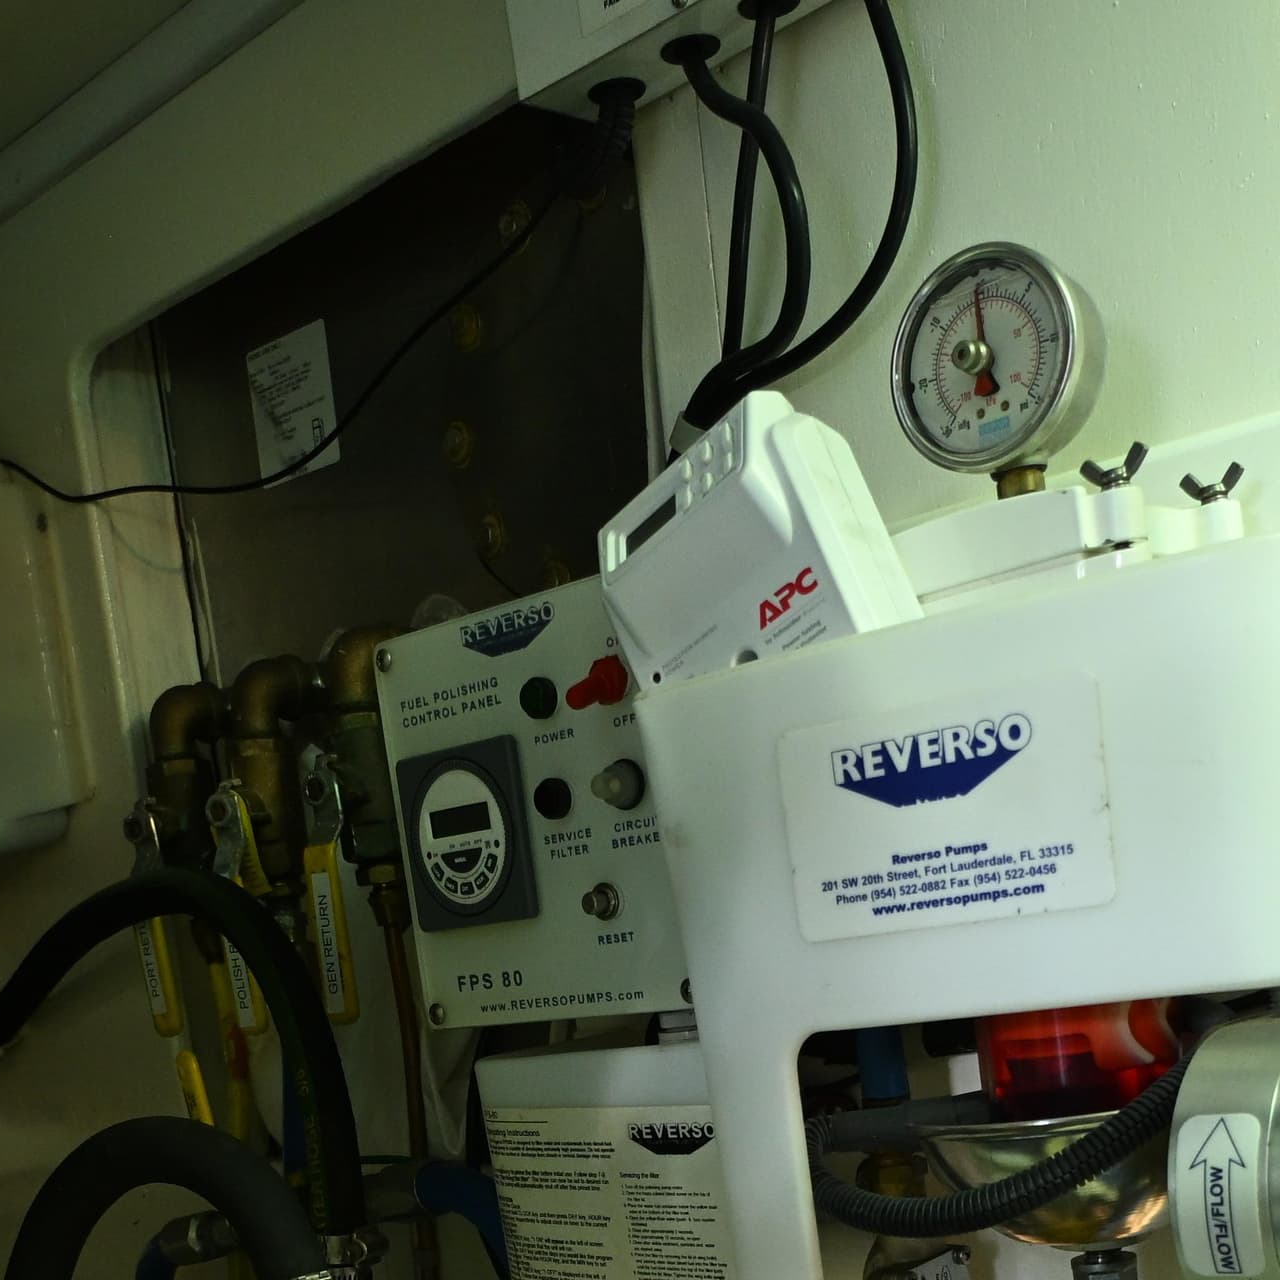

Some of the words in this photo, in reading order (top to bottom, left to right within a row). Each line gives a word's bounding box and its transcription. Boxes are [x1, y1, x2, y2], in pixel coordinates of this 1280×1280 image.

[759, 566, 819, 632] APC
[460, 602, 555, 646] REVERSO
[400, 696, 429, 714] FUEL
[433, 677, 499, 705] POLISHING
[402, 704, 459, 729] CONTROL
[461, 694, 502, 719] PANEL
[533, 728, 575, 746] POWER
[830, 713, 1032, 786] REVERSO
[543, 827, 593, 846] SERVICE
[611, 832, 660, 849] BREAKE
[613, 816, 658, 833] CIRCUI
[549, 843, 590, 861] FILTER
[821, 880, 839, 893] 201
[841, 876, 859, 890] SW
[861, 872, 884, 887] 20th
[924, 864, 948, 877] Fort
[950, 852, 1018, 874] Lauderdale,
[1020, 850, 1036, 862] FL
[1038, 844, 1074, 859] 33315
[891, 848, 942, 866] Reverso
[944, 841, 989, 860] Pumps
[835, 891, 869, 906] Phone
[870, 886, 897, 902] (954)
[899, 879, 948, 897] 522-0882
[950, 875, 971, 889] Fax
[973, 870, 1003, 888] (954)
[1004, 863, 1058, 882] 522-0456
[872, 881, 1046, 917] www.reversopumps.com
[317, 894, 336, 959] RETURN
[597, 931, 635, 947] RESET
[146, 959, 161, 998] PORT
[231, 962, 250, 1010] POLISH
[326, 962, 339, 995] GEN
[457, 971, 494, 994] FPS
[501, 969, 524, 989] 80
[480, 989, 645, 1015] www.REVERSOPUMPS.com
[627, 1120, 716, 1141] REVERSO
